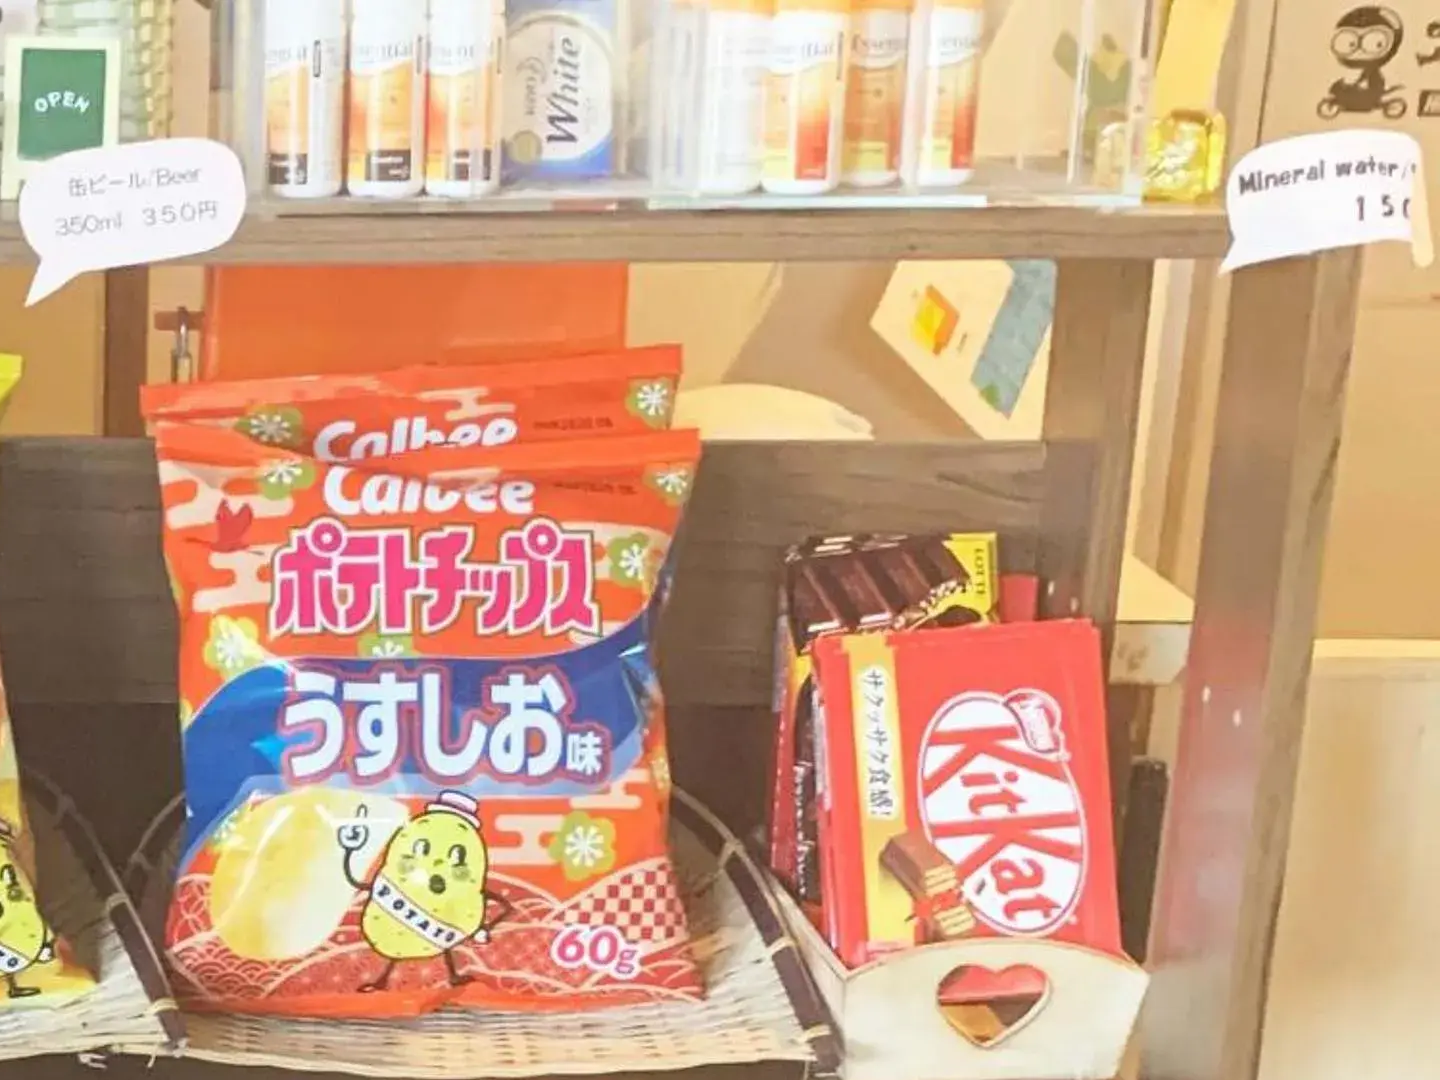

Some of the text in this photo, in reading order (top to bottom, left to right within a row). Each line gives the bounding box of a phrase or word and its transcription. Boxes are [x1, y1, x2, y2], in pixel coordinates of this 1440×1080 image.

[34, 91, 90, 113] OPEN
[546, 37, 579, 143] White
[1238, 159, 1326, 196] Mineral
[55, 210, 123, 237] 350ml
[268, 517, 603, 638] ポテトチップス
[922, 724, 1084, 922] KitKat
[375, 881, 457, 944] POTATO
[558, 929, 638, 976] 60g
